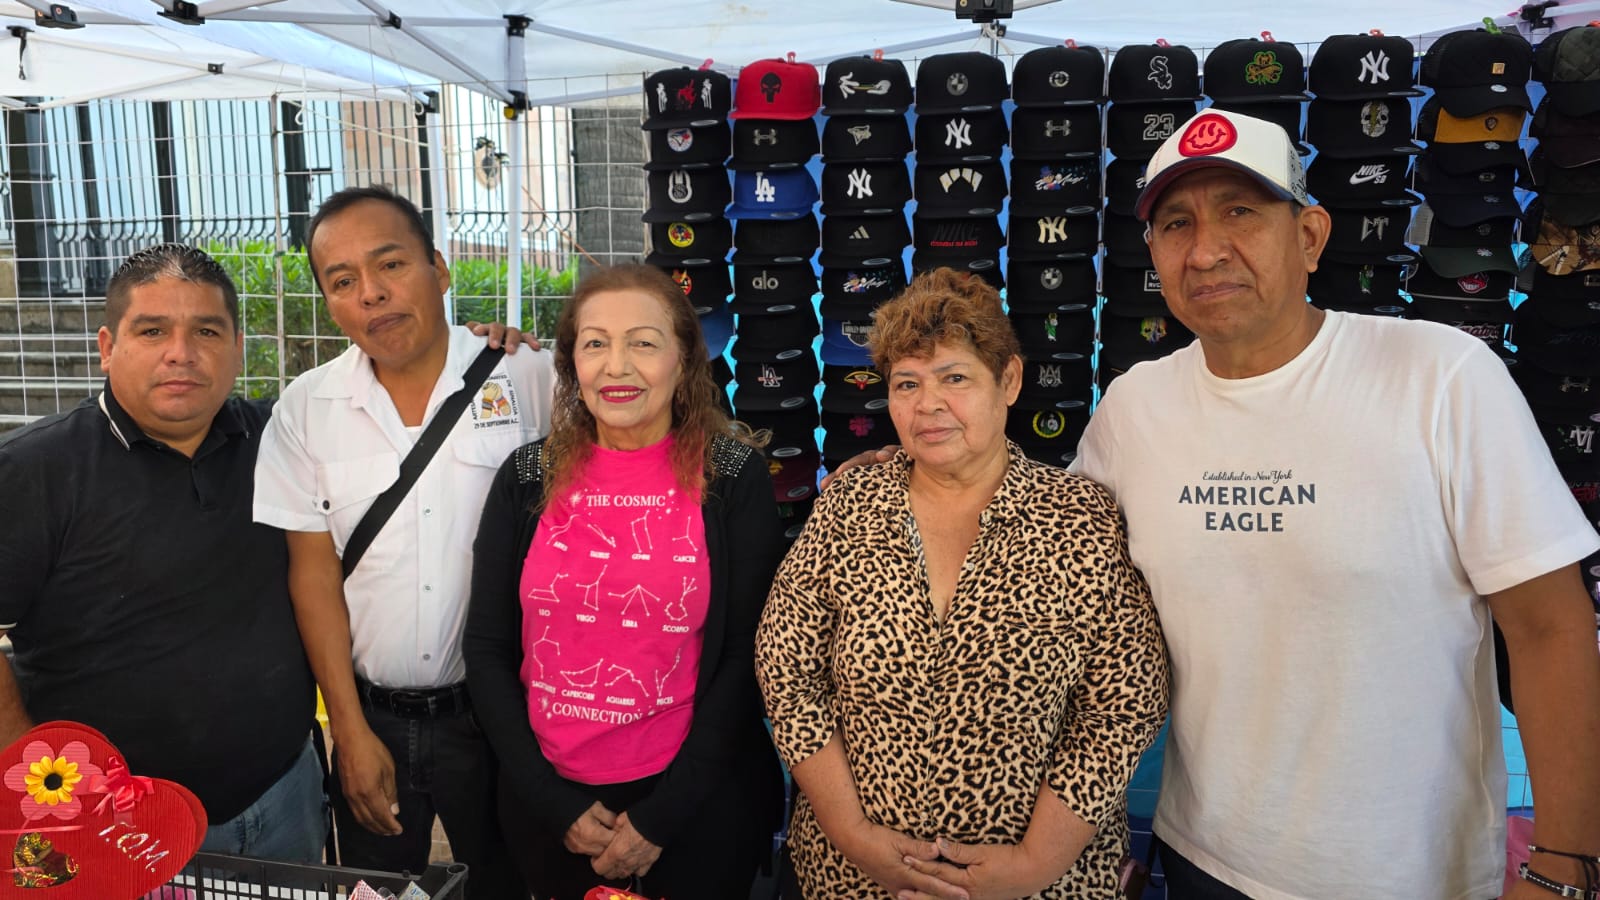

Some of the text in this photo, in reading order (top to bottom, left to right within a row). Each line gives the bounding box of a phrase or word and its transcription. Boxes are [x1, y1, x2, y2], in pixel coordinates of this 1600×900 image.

[1143, 114, 1174, 141] 23
[1357, 164, 1386, 176] NIKE
[755, 172, 775, 203] LA
[1374, 175, 1388, 184] SB
[752, 270, 779, 290] alo
[1202, 470, 1293, 484] Established in New York
[586, 494, 666, 506] THE COSMIC
[1178, 484, 1316, 506] AMERICAN
[1205, 512, 1284, 532] EAGLE
[673, 555, 697, 564] CANCER
[576, 614, 596, 624] VIRGO
[552, 703, 643, 726] CONNECTION
